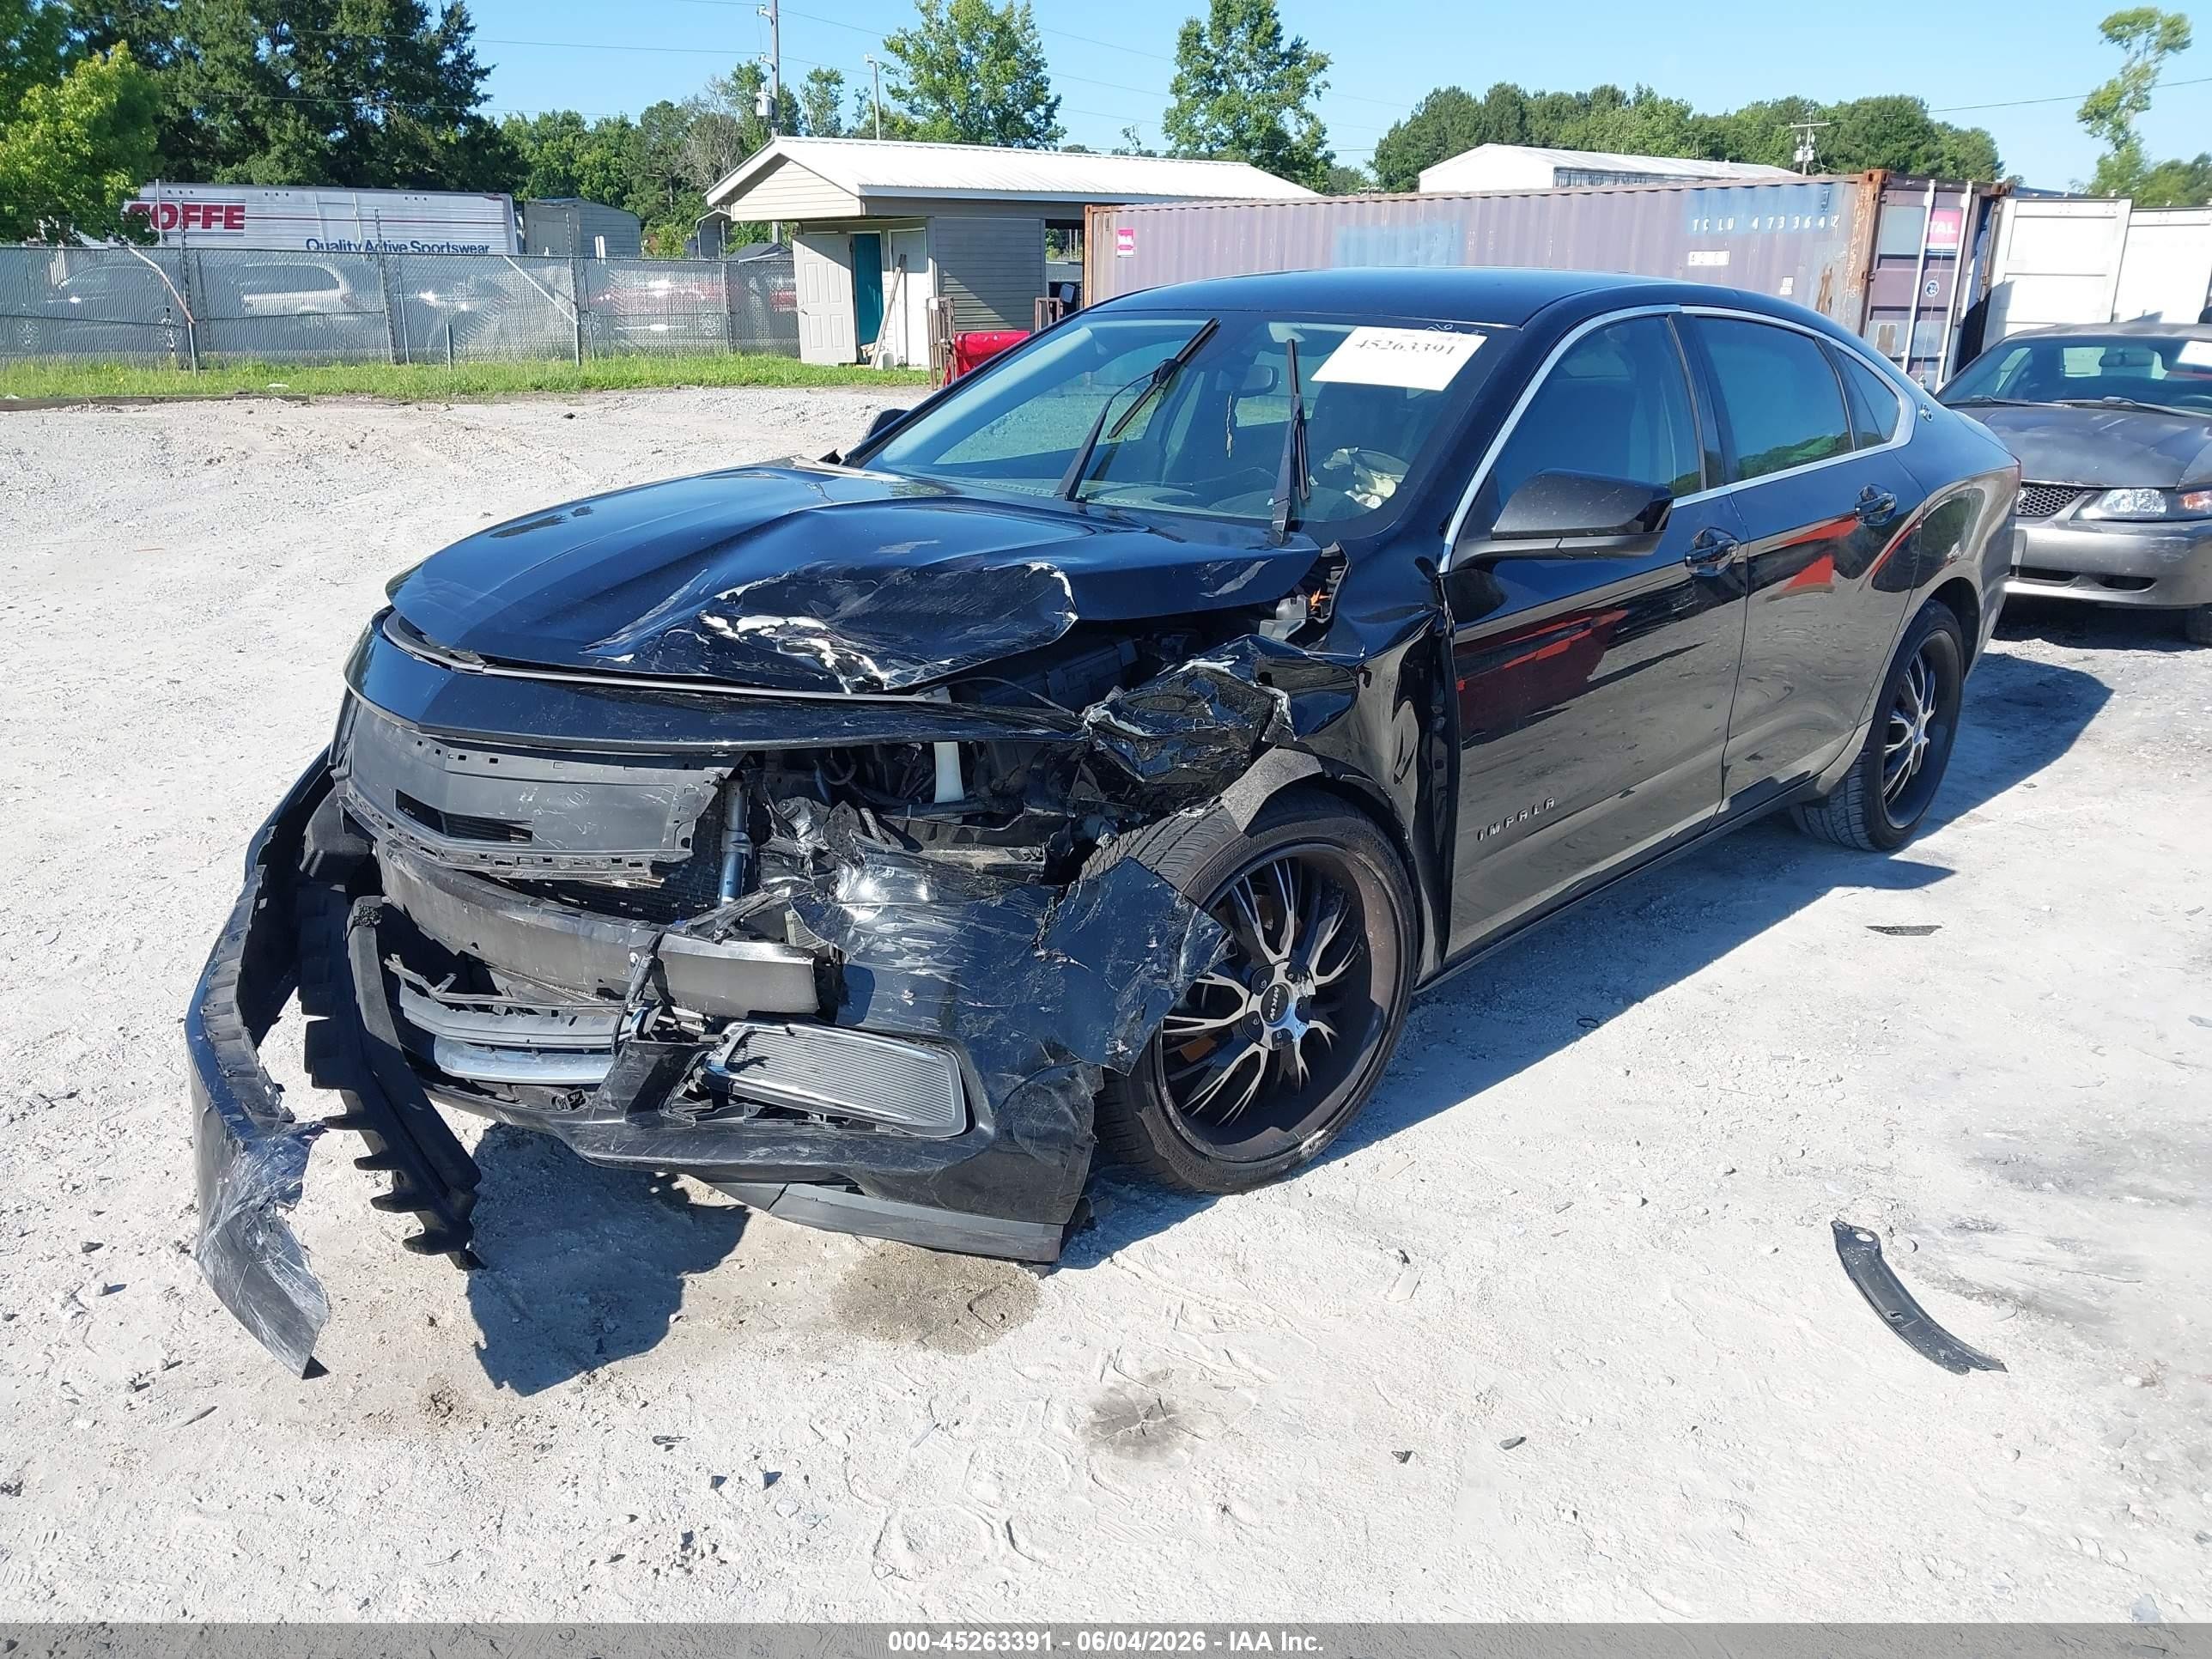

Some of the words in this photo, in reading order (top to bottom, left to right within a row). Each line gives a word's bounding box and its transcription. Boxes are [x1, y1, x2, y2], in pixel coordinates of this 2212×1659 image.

[306, 238, 362, 252] Quality
[365, 239, 408, 252] Active
[410, 240, 490, 254] Sportswear
[1477, 797, 1556, 842] IMPALA
